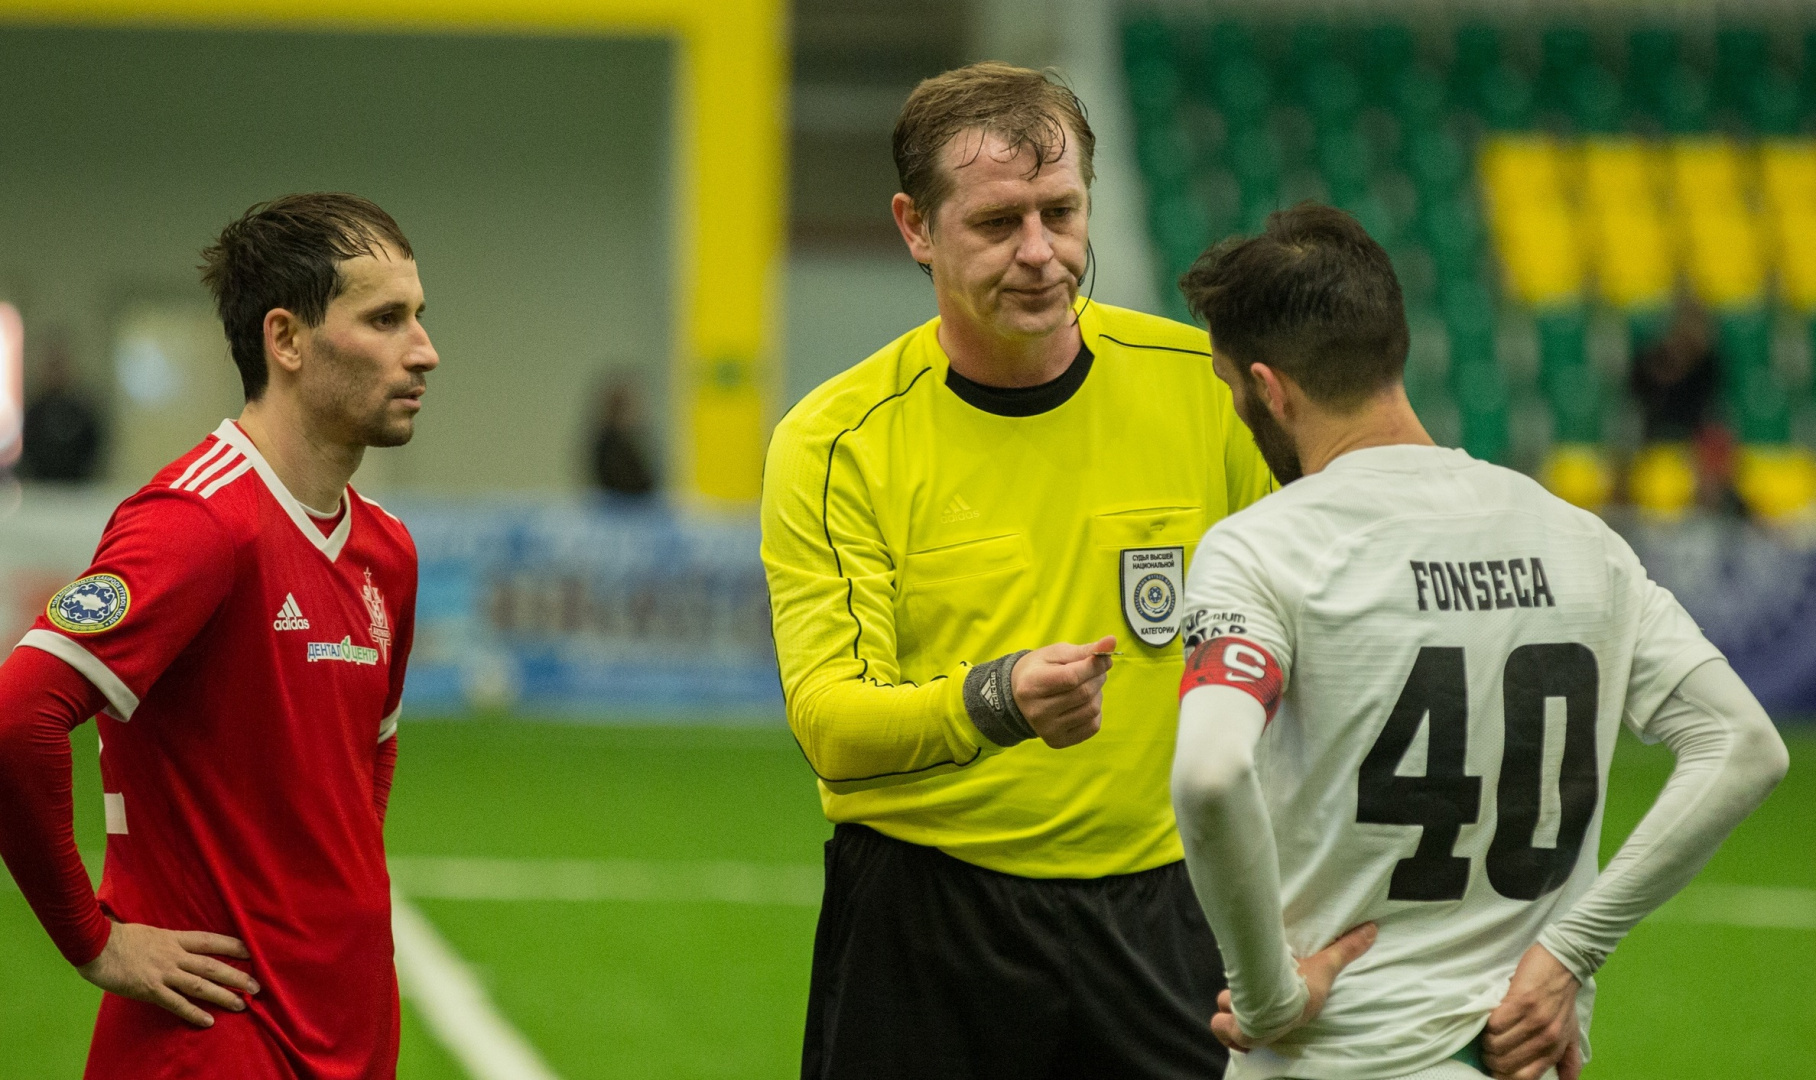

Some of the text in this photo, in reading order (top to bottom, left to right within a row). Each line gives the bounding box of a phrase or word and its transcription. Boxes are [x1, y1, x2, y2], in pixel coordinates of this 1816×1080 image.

[941, 509, 980, 524] adidas
[1132, 552, 1174, 562] СУДЬЯ ВЫСШЕЙ
[1132, 560, 1175, 569] НАЦИОНАЛЬНОЙ
[1409, 557, 1556, 611] FONSECA
[273, 617, 310, 631] adidas
[1141, 626, 1175, 635] КАТЕГОРИИ
[308, 643, 377, 661] ДЕНТАЛ ЦЕНТР
[990, 671, 1000, 710] adidas
[1355, 642, 1600, 902] 40
